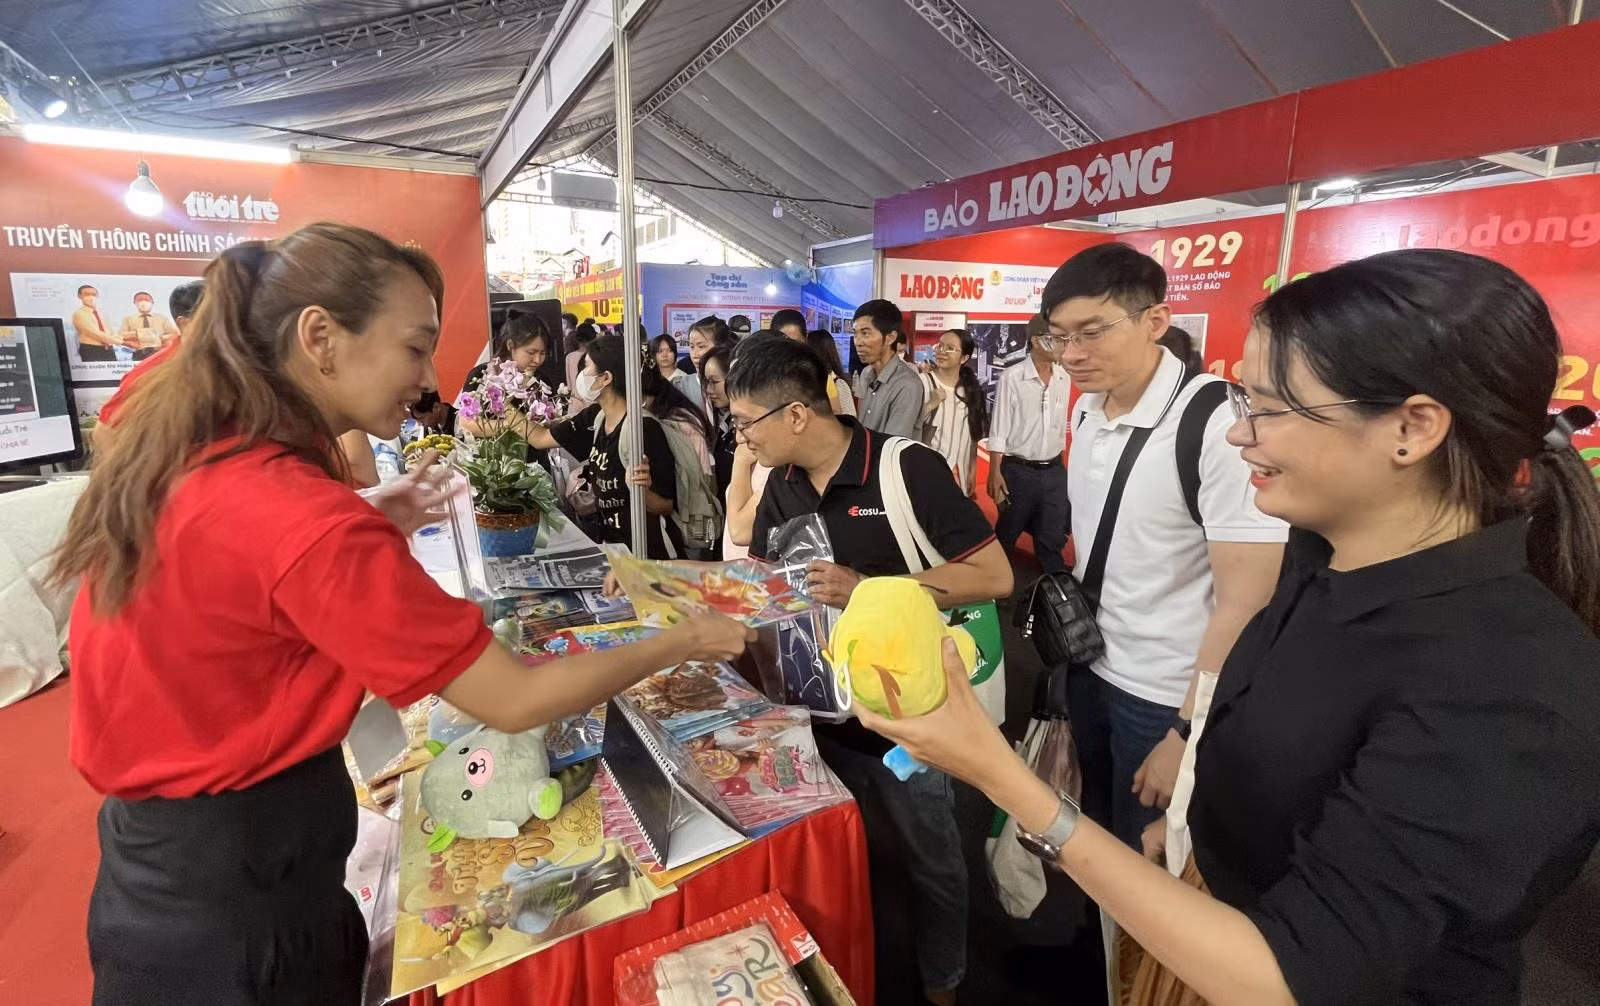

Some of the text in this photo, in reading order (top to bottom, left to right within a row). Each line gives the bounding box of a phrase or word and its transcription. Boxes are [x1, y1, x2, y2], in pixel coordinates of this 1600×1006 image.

[3, 223, 257, 253] TRUYỀN THÔNG CHÍNH SÁ
[1151, 231, 1243, 269] 1929
[1190, 273, 1206, 281] LAO
[1207, 270, 1231, 281] ĐỘNG
[1192, 281, 1203, 291] SỐ
[1204, 281, 1221, 290] BÁO
[592, 299, 610, 317] 10
